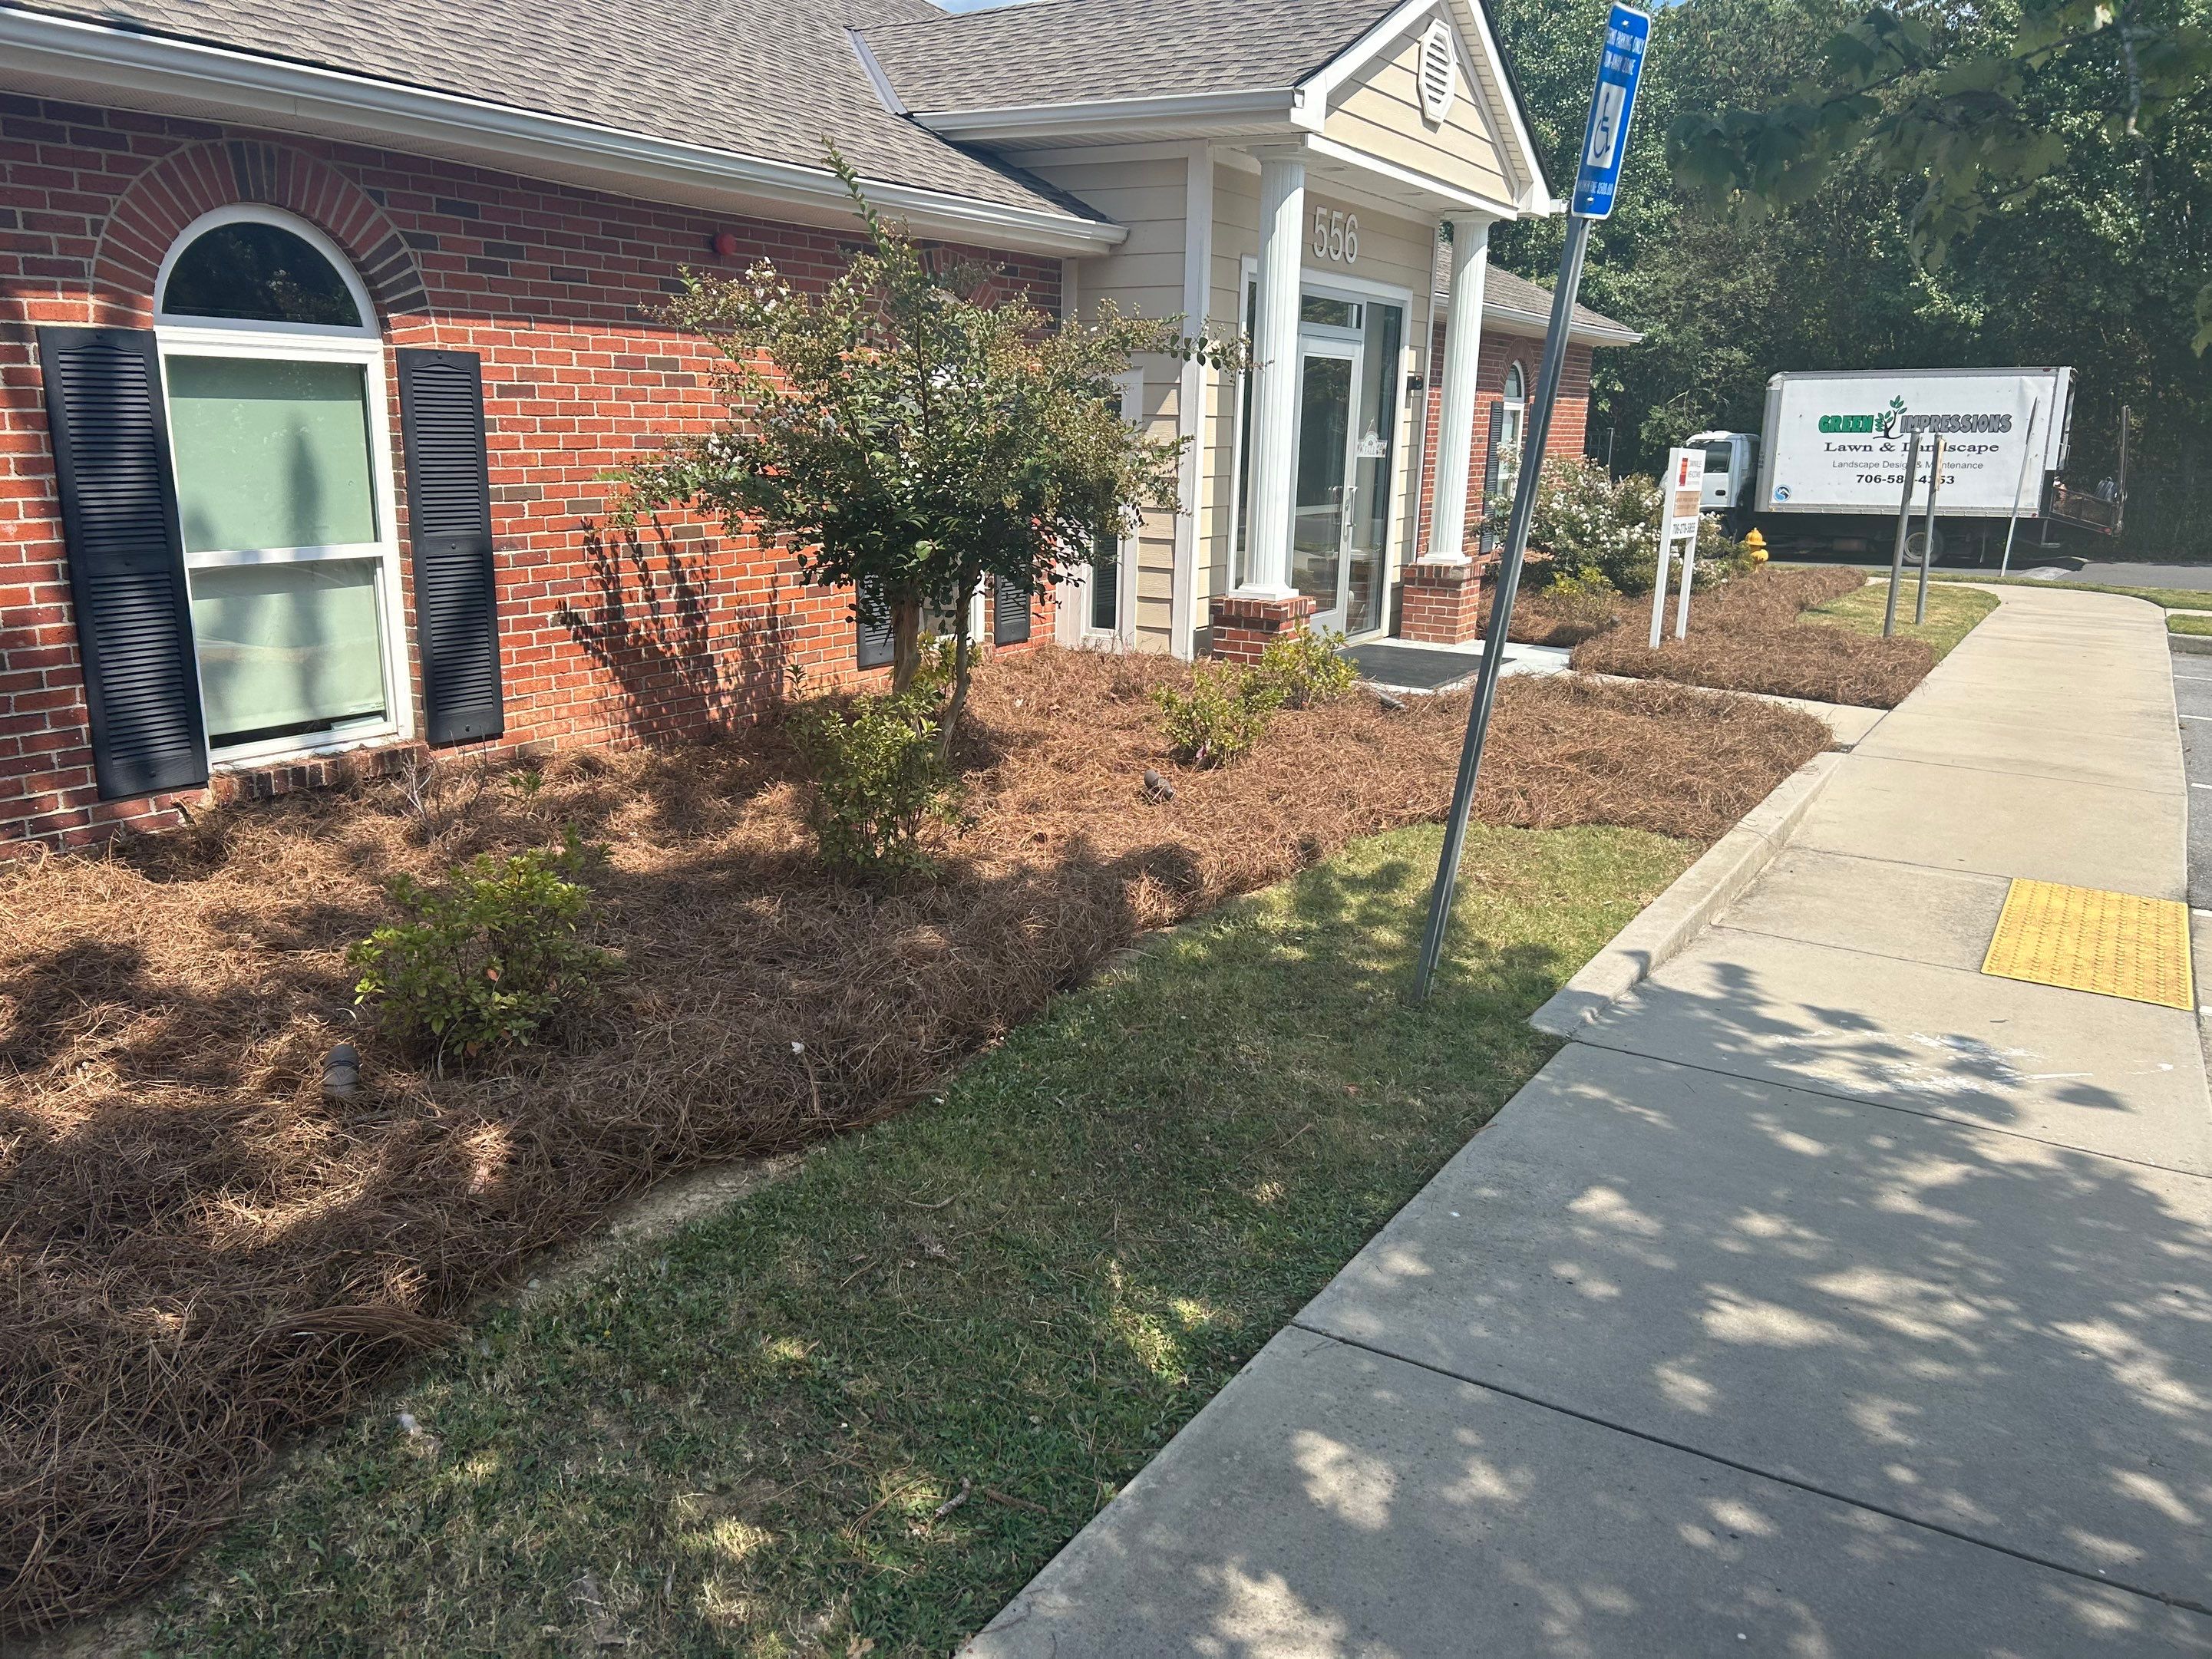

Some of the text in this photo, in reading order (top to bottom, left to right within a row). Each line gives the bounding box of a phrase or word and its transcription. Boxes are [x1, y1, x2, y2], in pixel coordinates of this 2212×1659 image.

[1312, 206, 1359, 265] 556
[1818, 414, 2012, 434] GREEN IMPRESSIONS
[1824, 441, 1874, 453] Lawn
[1879, 442, 1896, 453] &
[1832, 460, 1984, 471] Landscape Desig & Mntenance
[1856, 474, 1955, 486] 706-58-453
